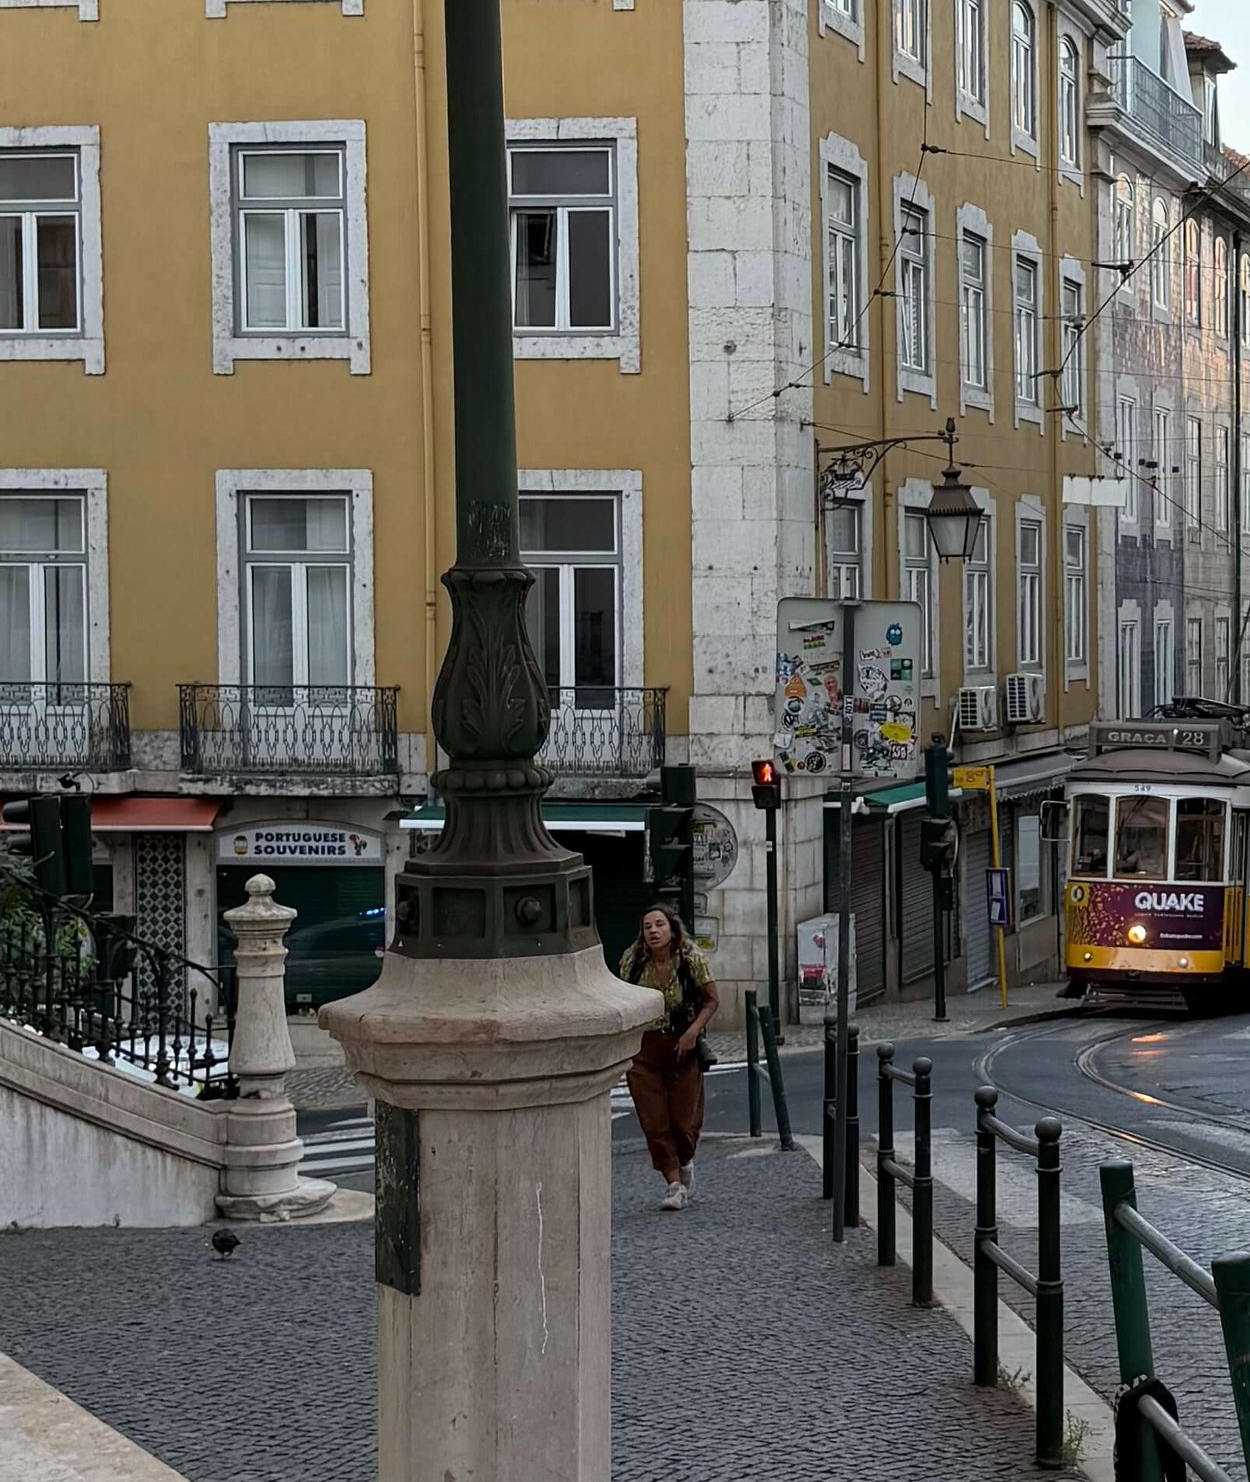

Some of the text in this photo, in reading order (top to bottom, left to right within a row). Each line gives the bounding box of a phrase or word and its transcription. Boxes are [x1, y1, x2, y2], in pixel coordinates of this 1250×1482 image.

[1182, 731, 1205, 746] 28
[254, 832, 347, 843] PORTUGUESE
[253, 844, 347, 856] SOUVENIRS
[1134, 891, 1205, 913] QUAKE
